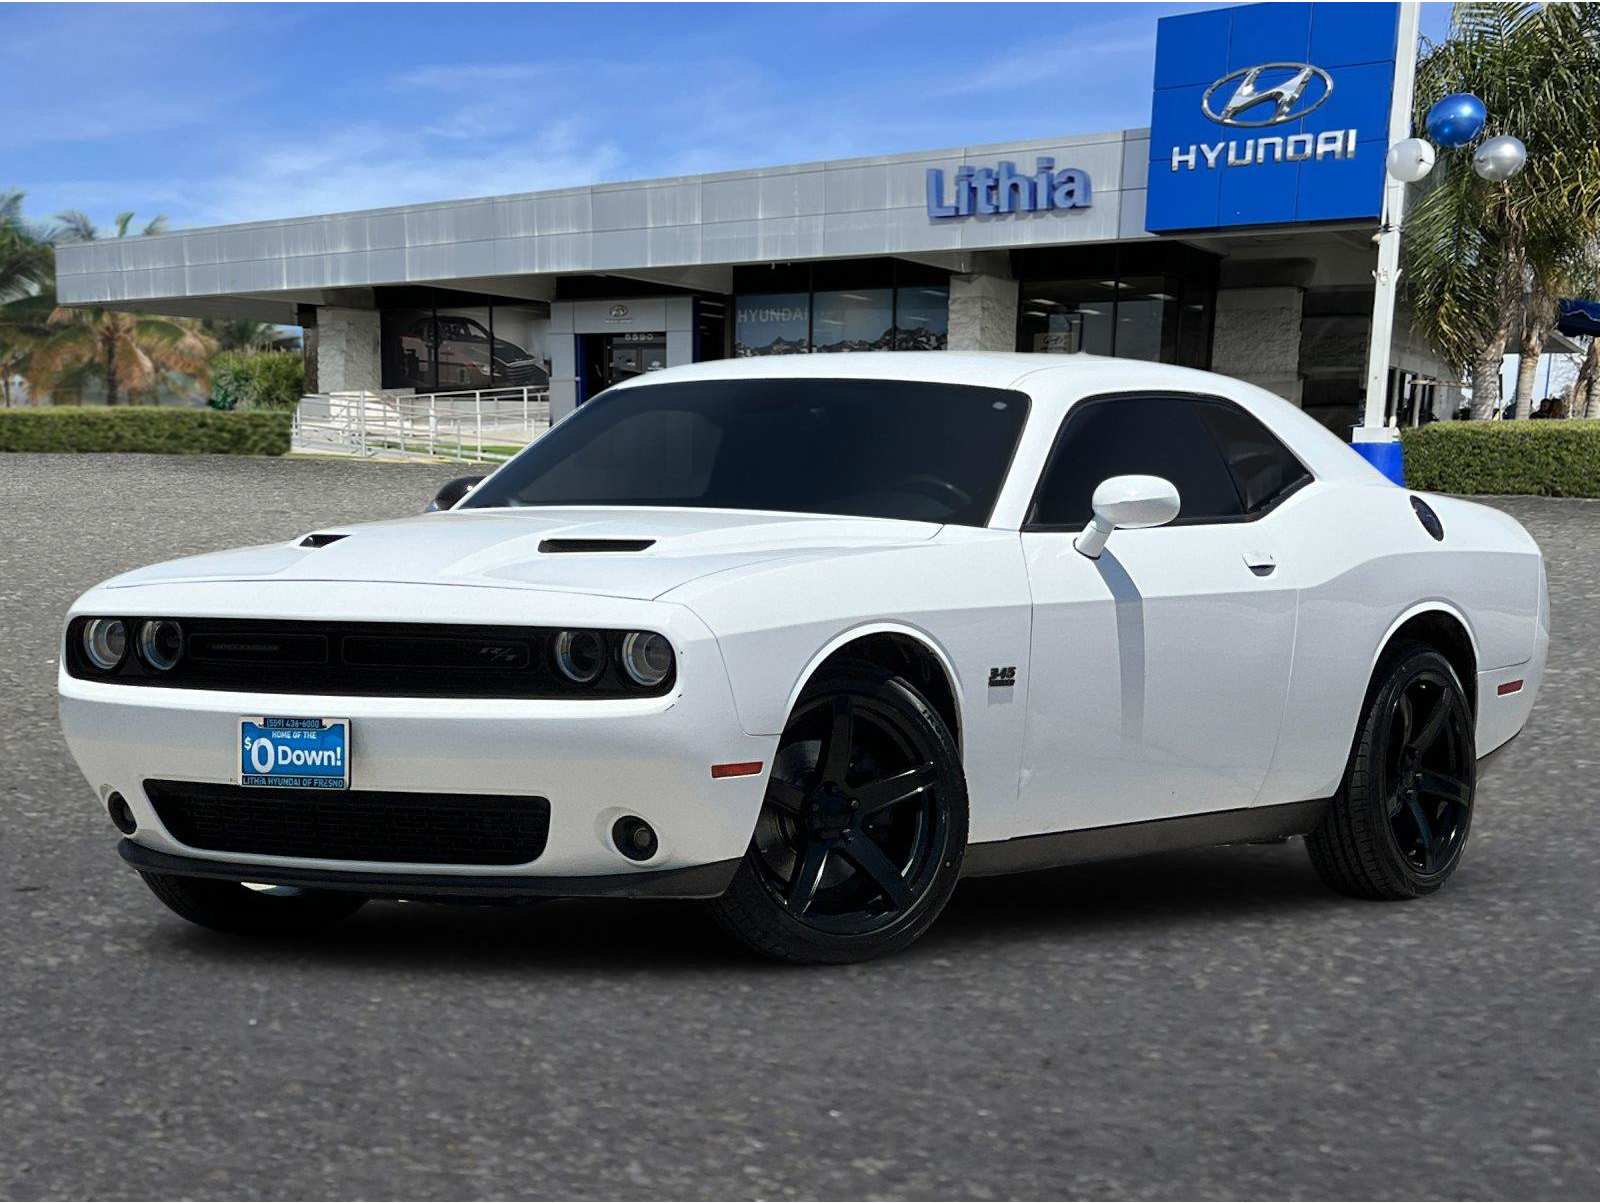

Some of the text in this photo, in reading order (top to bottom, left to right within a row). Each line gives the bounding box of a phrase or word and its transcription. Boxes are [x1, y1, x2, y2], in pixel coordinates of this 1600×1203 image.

[1171, 128, 1358, 172] HYUNDAI
[926, 156, 1092, 220] Lithia
[737, 307, 808, 323] HYUNDAI
[271, 730, 317, 740] HOME OF THE
[277, 745, 342, 766] Down!
[243, 776, 266, 786] LITHIA
[268, 777, 301, 787] HYUNDAI
[302, 778, 313, 787] OF
